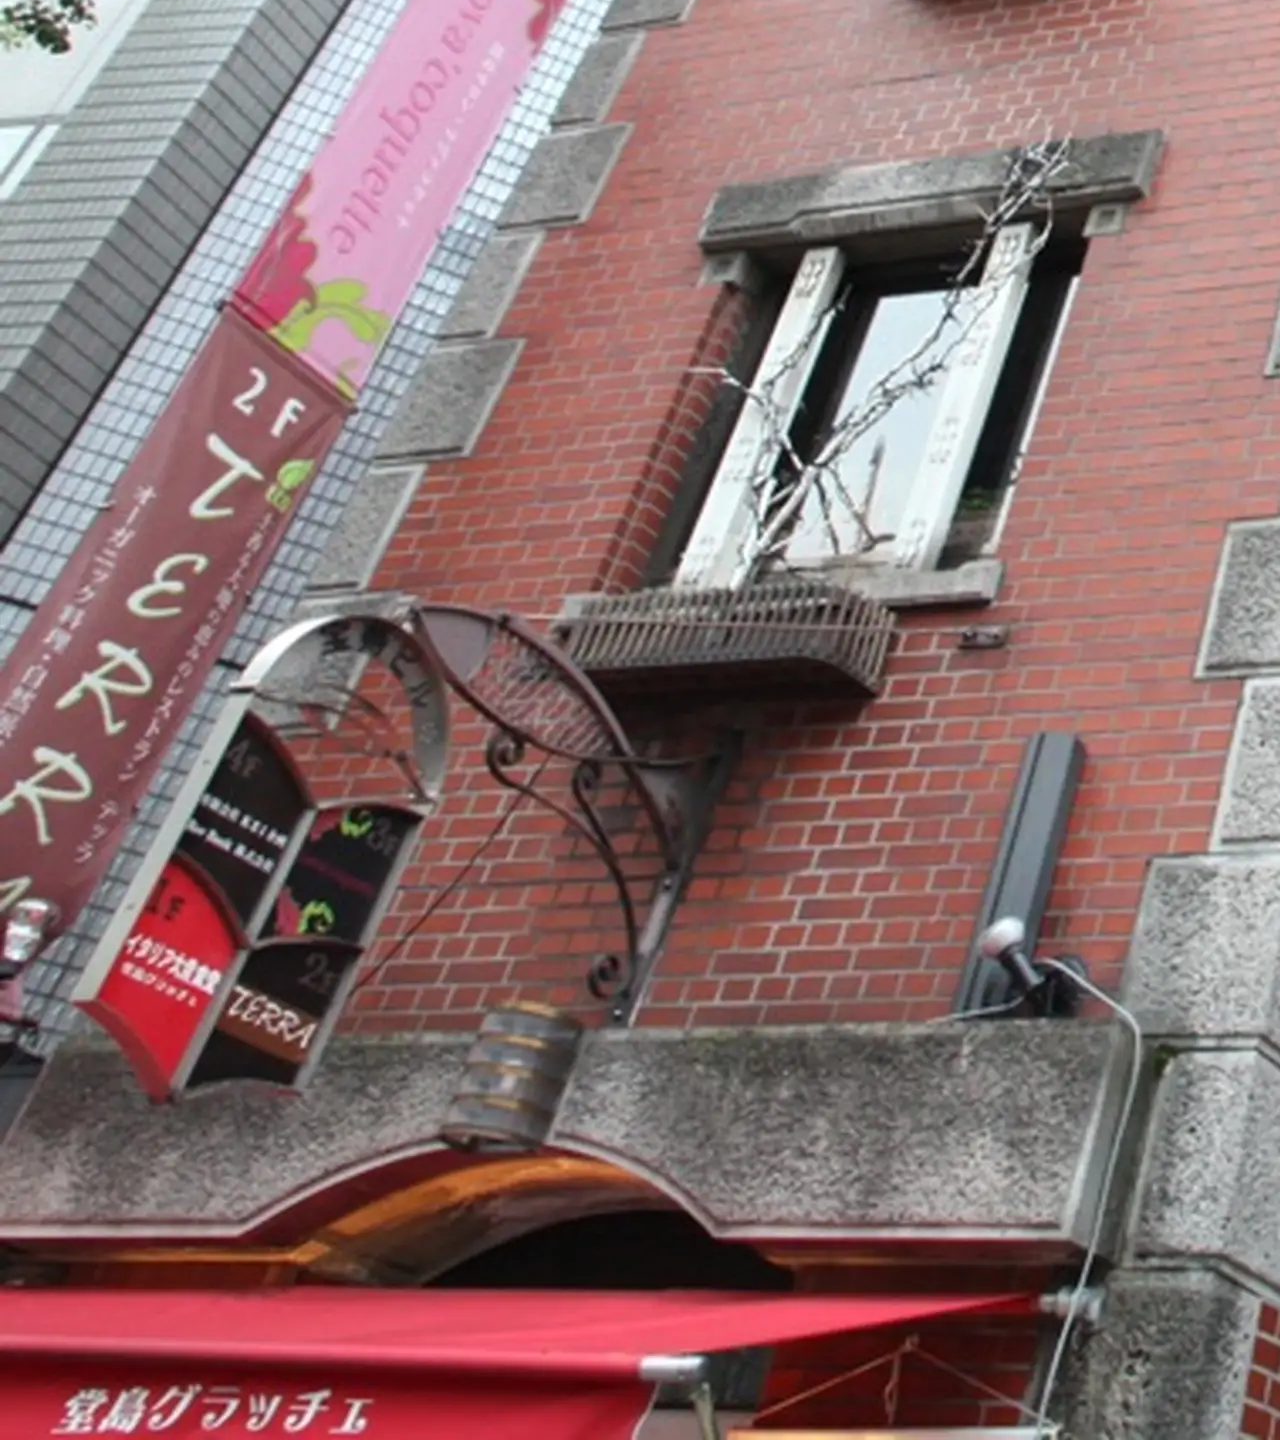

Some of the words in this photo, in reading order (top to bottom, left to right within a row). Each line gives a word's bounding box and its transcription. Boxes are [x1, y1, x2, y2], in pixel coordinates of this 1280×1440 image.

[231, 366, 307, 438] 2F
[228, 984, 318, 1050] TERRA
[50, 1383, 374, 1435] 堂島グラッチェ
